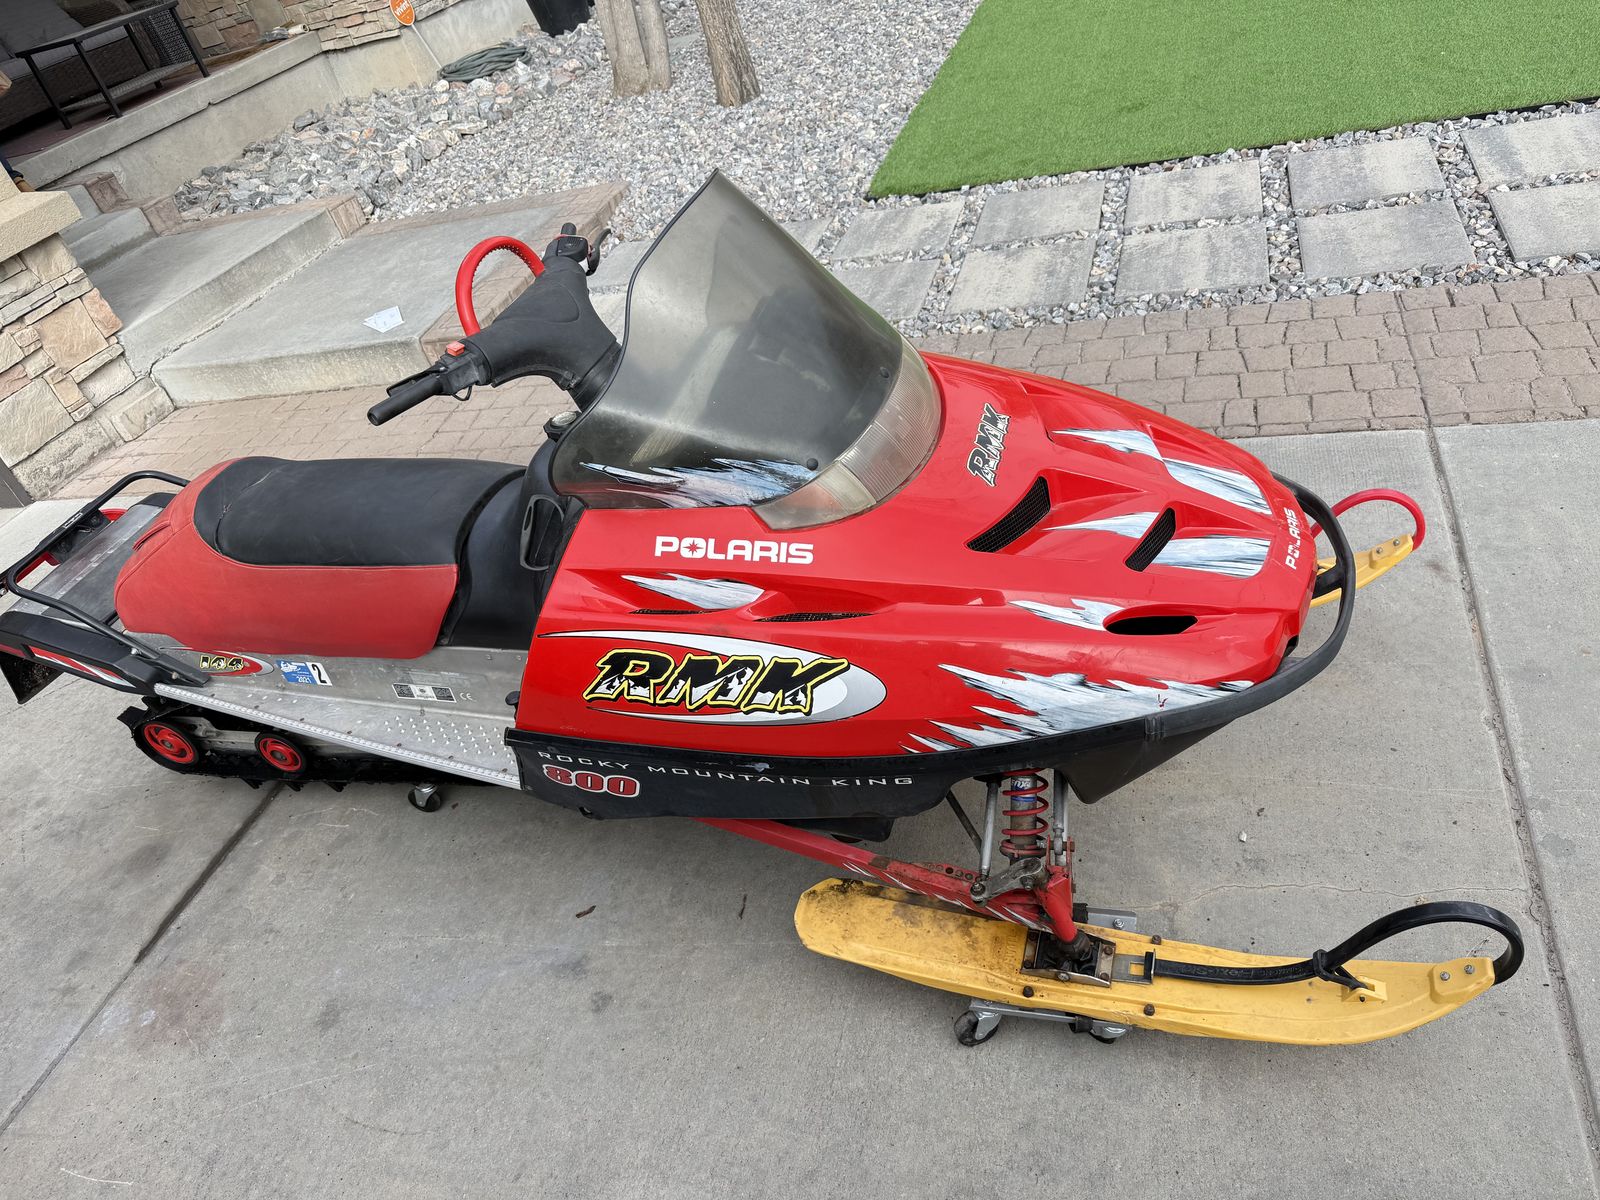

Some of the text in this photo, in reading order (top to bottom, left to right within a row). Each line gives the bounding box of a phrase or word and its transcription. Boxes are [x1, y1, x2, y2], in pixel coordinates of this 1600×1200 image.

[966, 402, 1010, 487] RMK
[654, 535, 814, 565] POLARIS
[1284, 507, 1301, 570] POLARIS
[200, 655, 244, 671] 144
[311, 663, 328, 684] 2
[582, 648, 850, 715] RMK
[537, 751, 913, 787] ROCKY MOUNTAIN KING
[542, 764, 641, 798] 800
